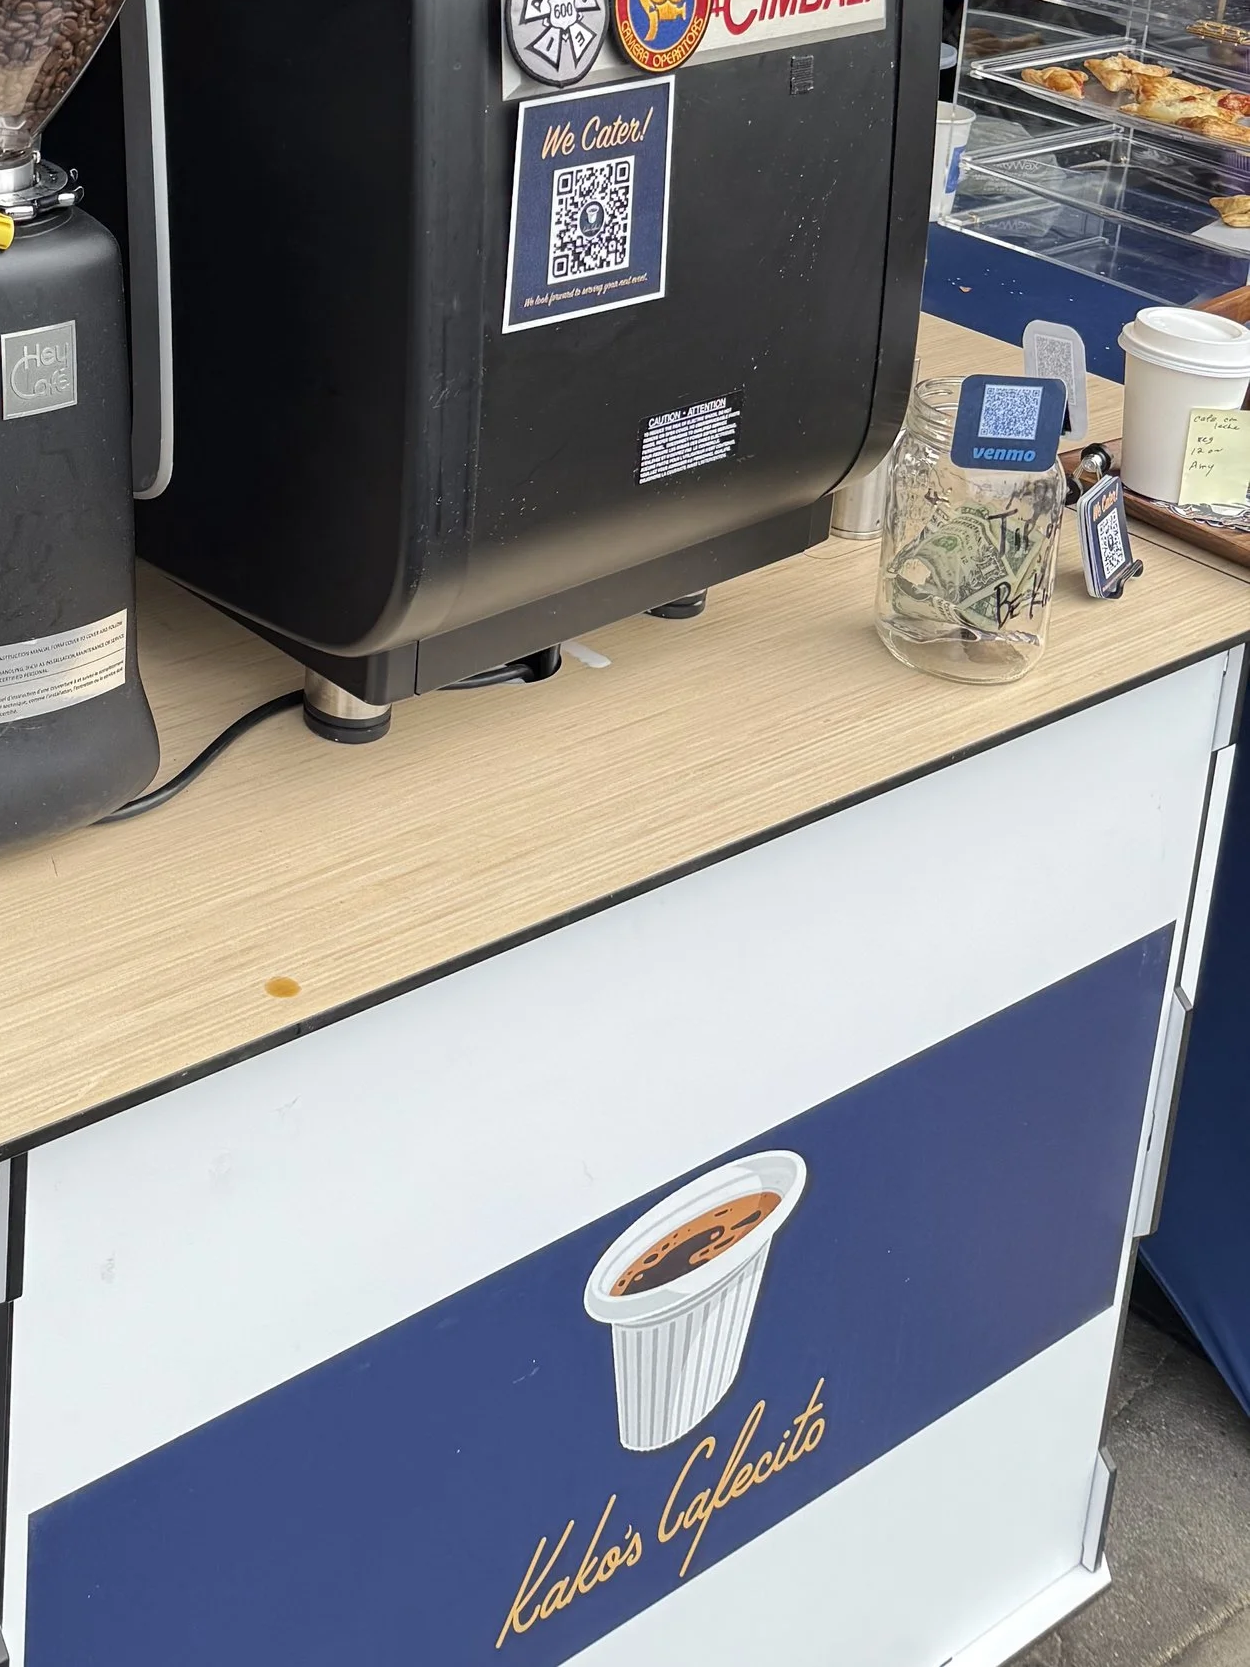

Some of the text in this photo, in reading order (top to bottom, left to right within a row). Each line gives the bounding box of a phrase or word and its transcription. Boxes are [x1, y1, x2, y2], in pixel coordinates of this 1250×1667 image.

[553, 2, 574, 21] 600
[621, 16, 704, 67] CAMERA OPERATORS
[541, 106, 653, 160] We Cater!
[23, 341, 69, 369] Hey
[648, 397, 727, 429] CAUTION ATTENTION
[972, 446, 1037, 463] venmo
[495, 1377, 825, 1649] Kako's Cafecito
